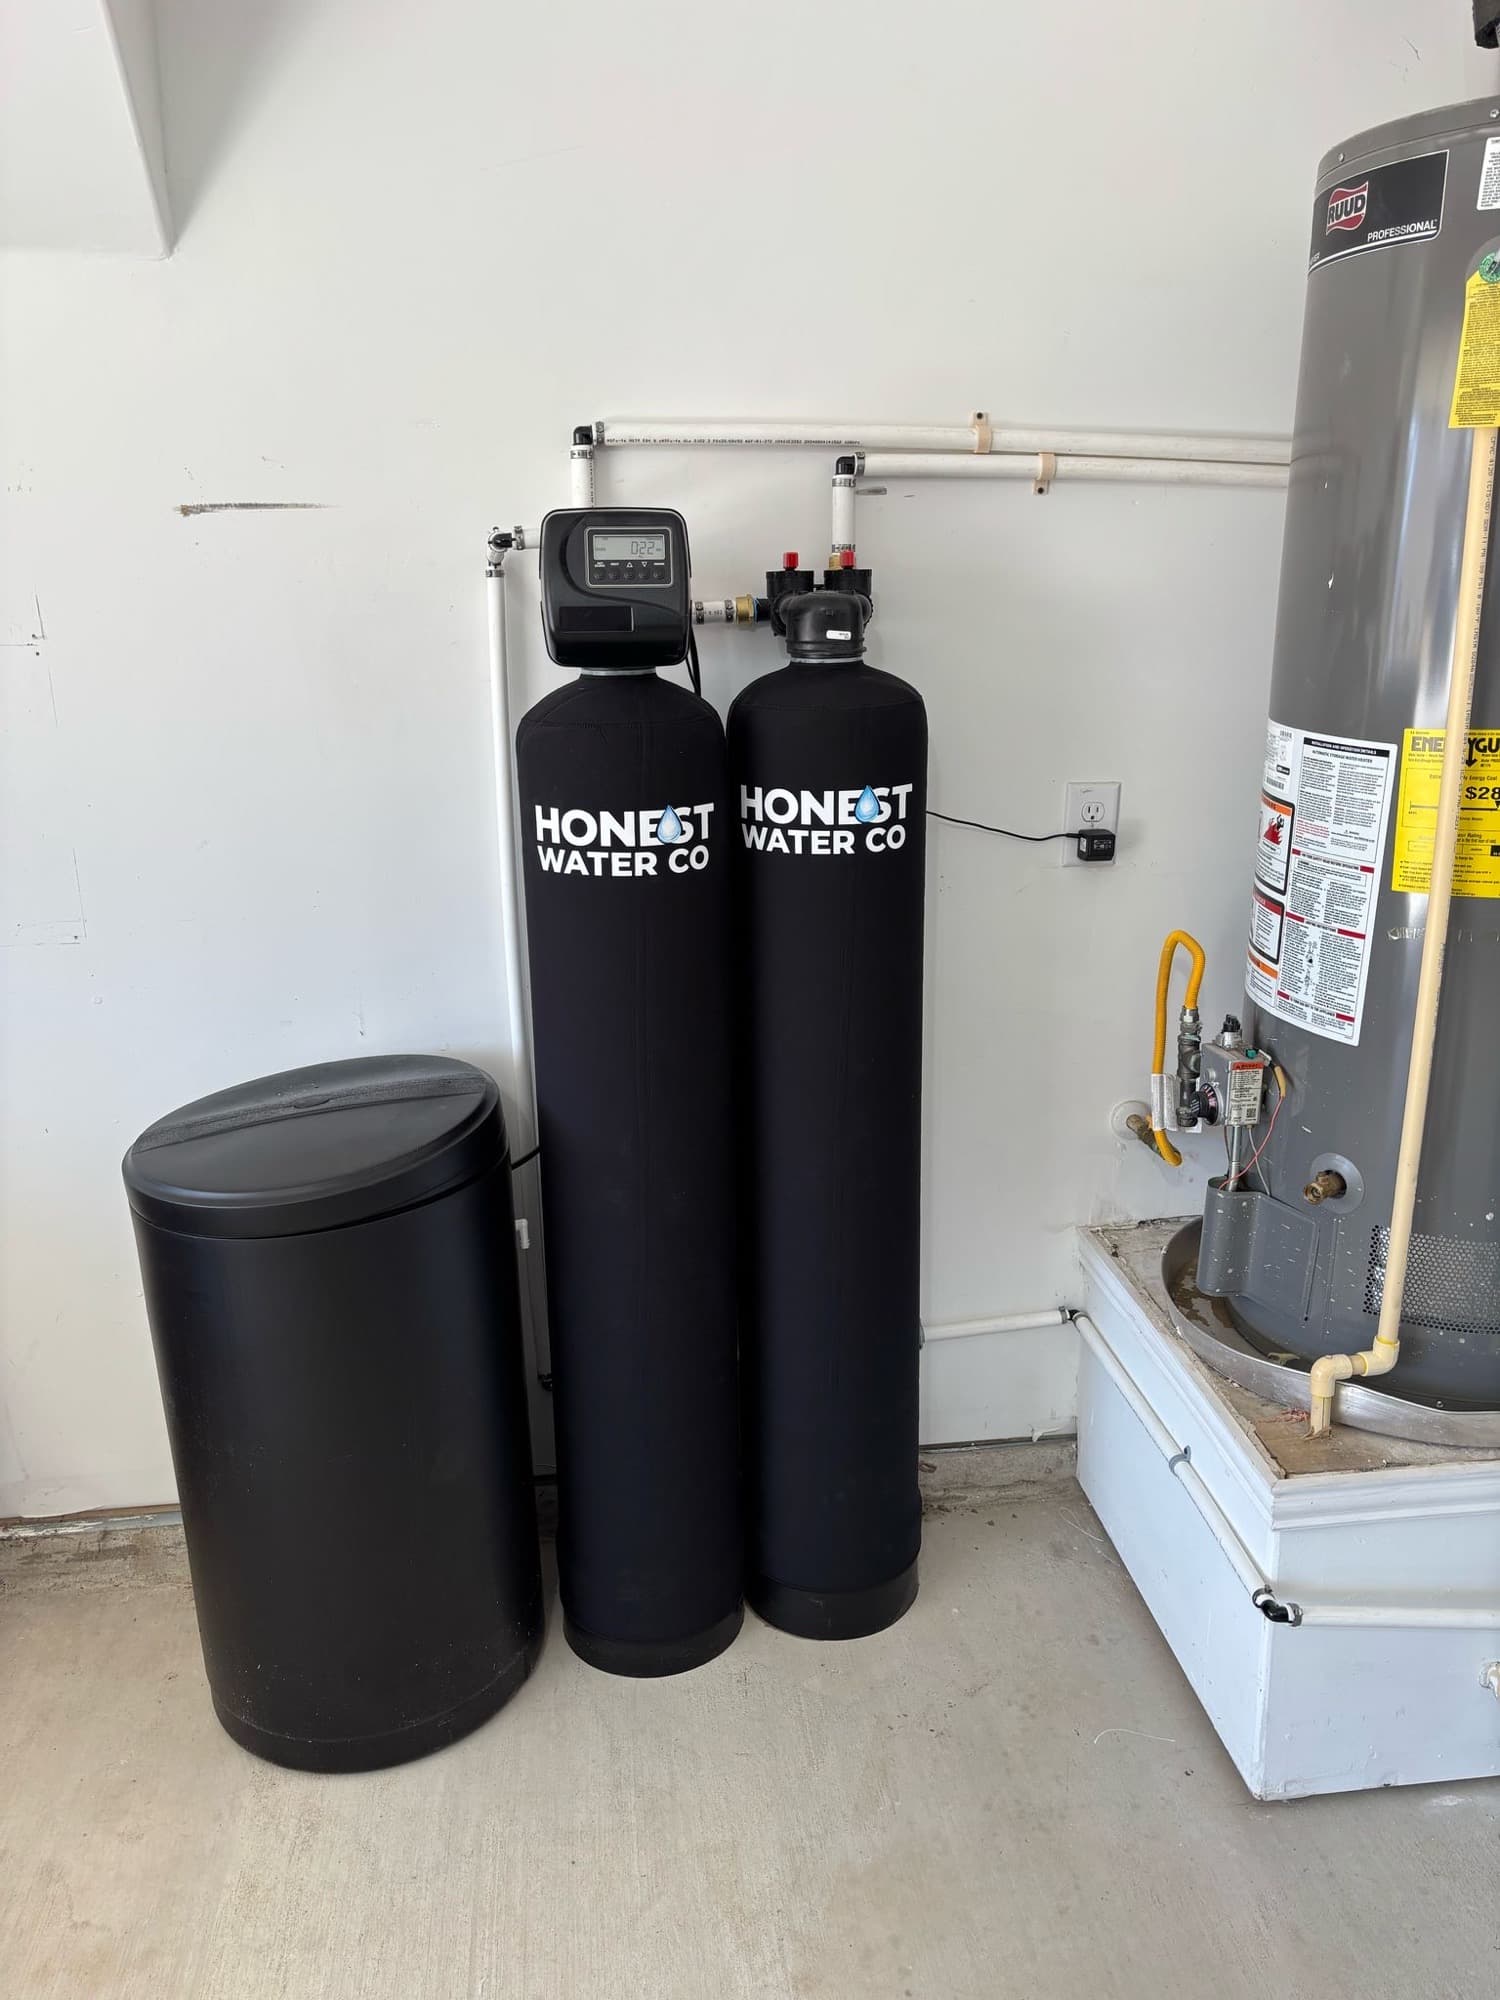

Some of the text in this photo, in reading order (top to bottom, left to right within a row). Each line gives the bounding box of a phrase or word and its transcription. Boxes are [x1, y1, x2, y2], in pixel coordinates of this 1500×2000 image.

[1328, 194, 1366, 224] RUUD
[1367, 221, 1438, 242] PROFESSIONAL
[740, 783, 913, 825] HONEST
[535, 802, 715, 847] HONEST
[741, 823, 906, 855] WATER CO
[537, 844, 709, 876] WATER CO
